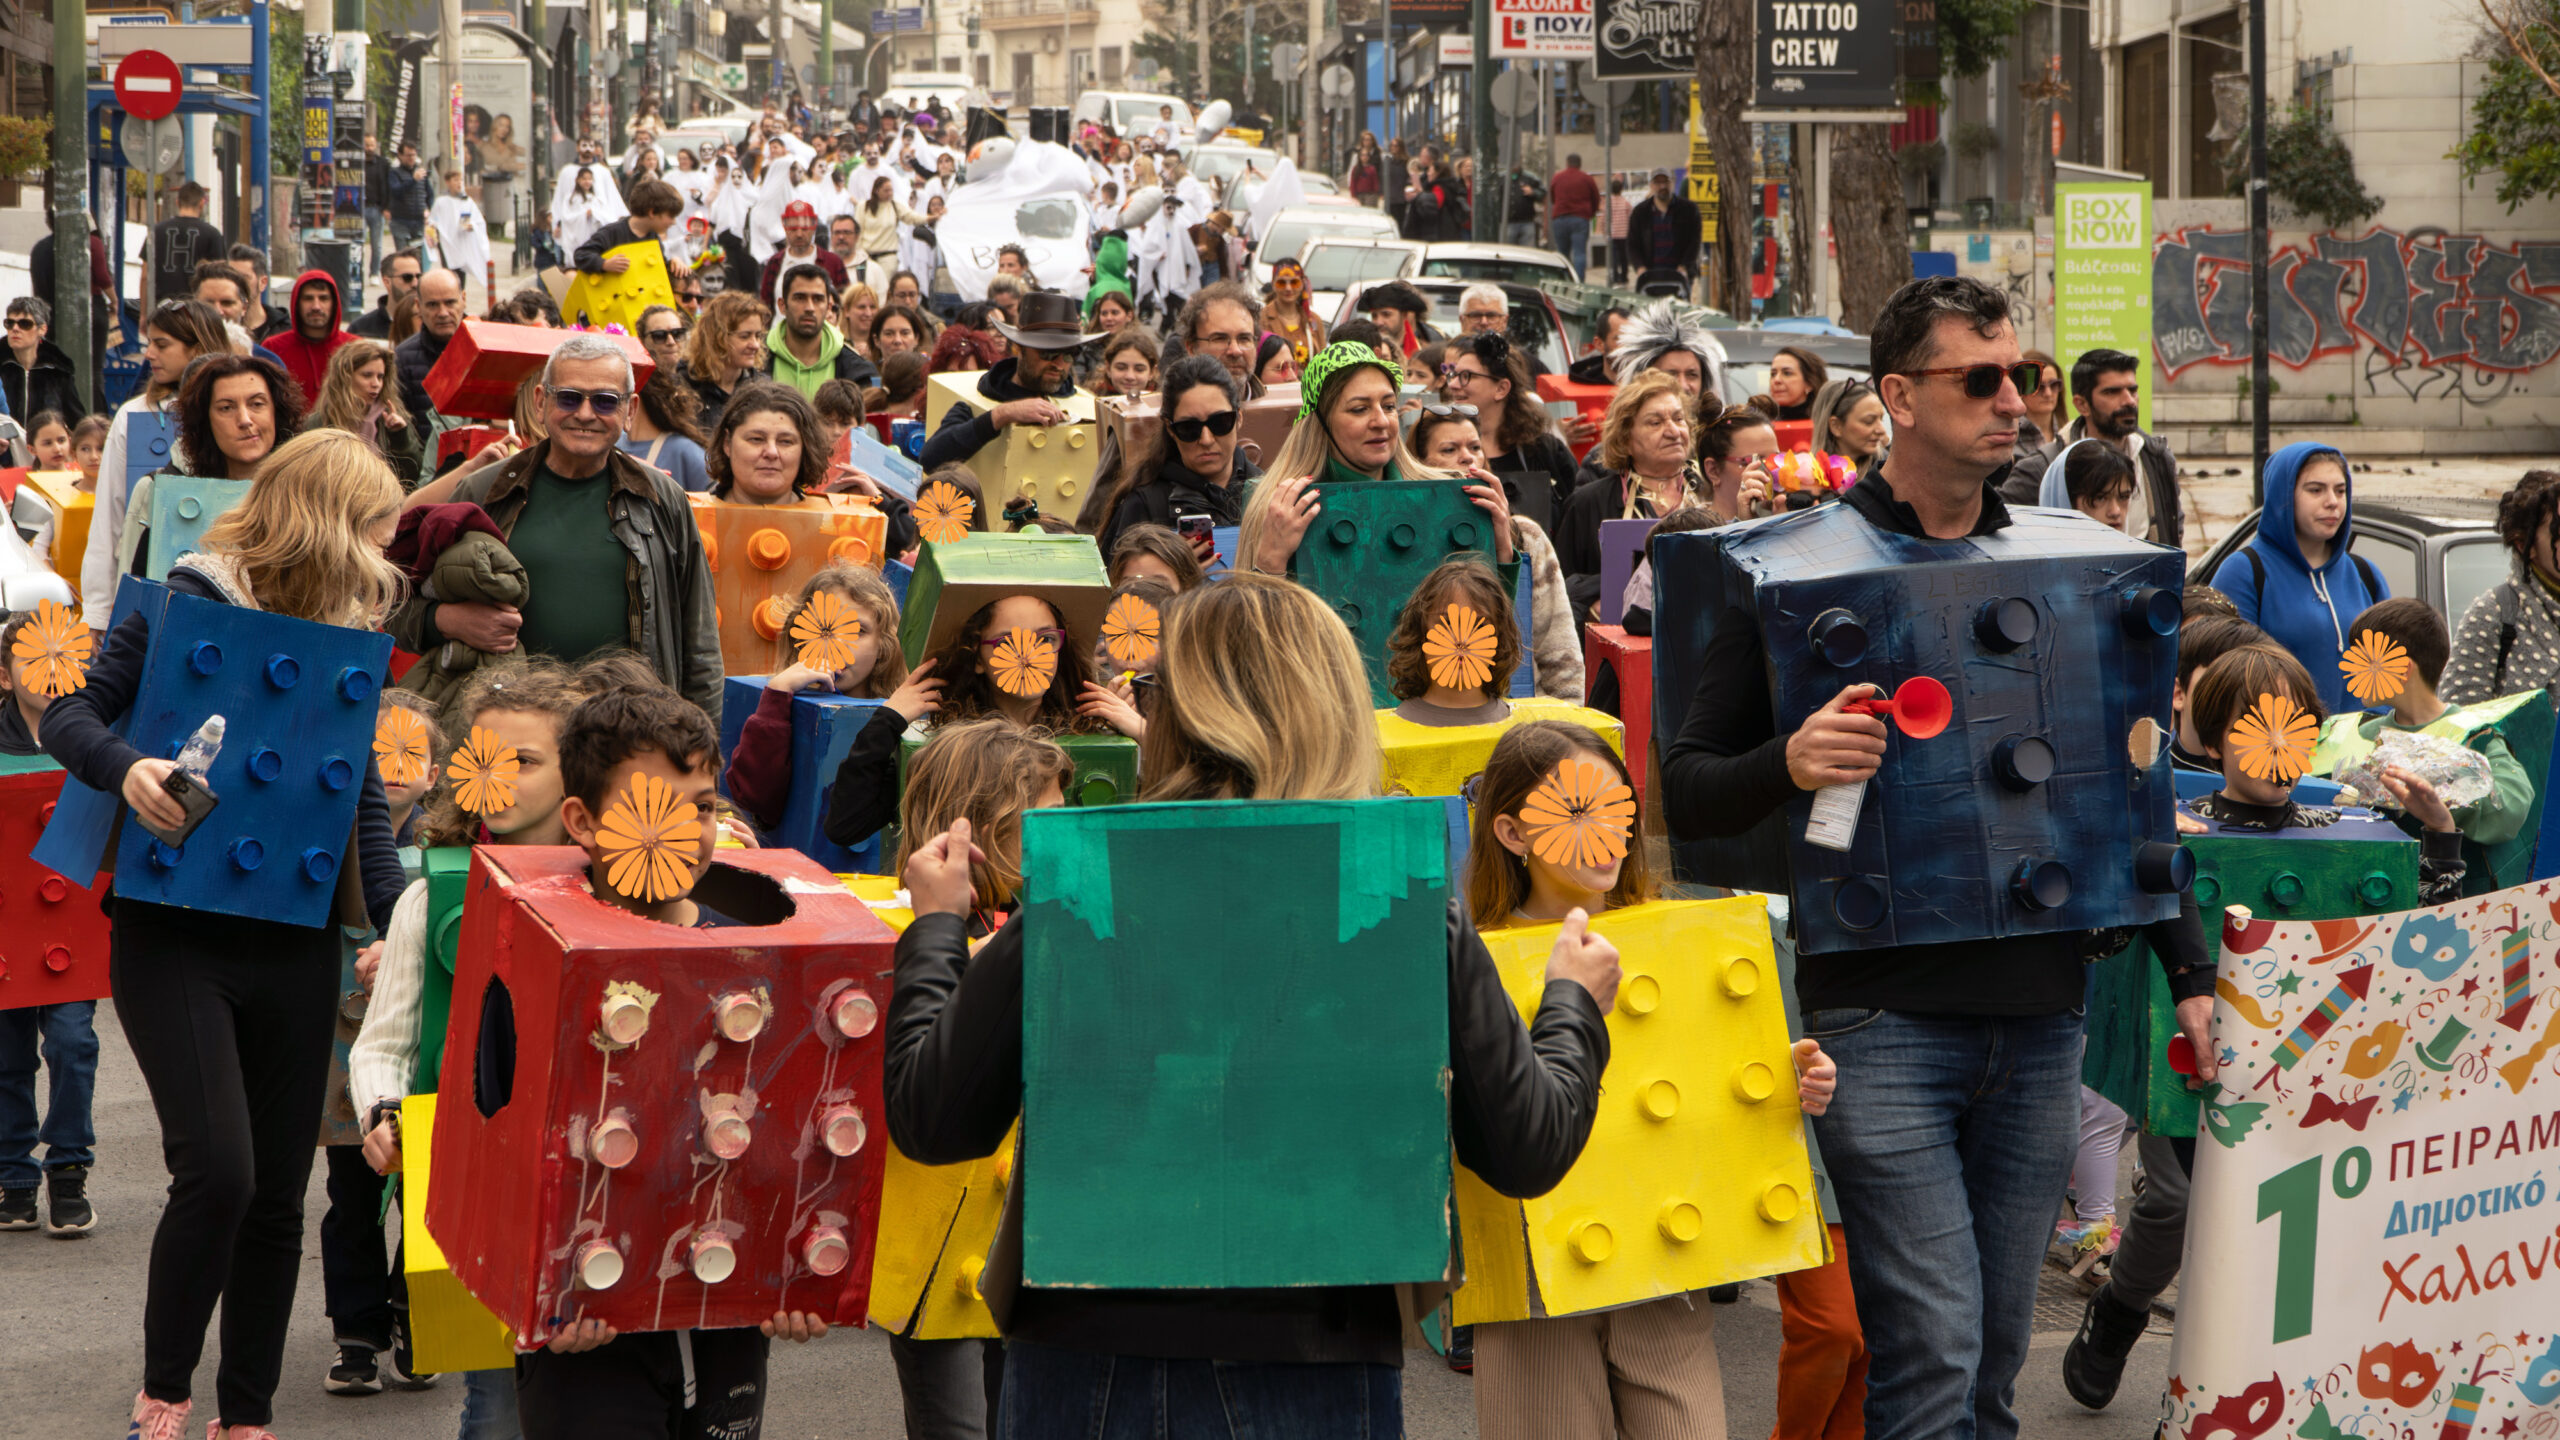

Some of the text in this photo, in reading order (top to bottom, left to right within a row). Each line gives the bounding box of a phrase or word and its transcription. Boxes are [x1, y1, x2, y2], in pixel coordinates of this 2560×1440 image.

[1772, 3, 1858, 31] TATTOO
[1771, 38, 1840, 67] CREW
[2071, 199, 2131, 221] BOX
[2071, 221, 2136, 243] NOW
[163, 227, 200, 274] H
[2064, 258, 2142, 277] Βιάζεσαι;
[2064, 283, 2103, 296] Στείλε
[2065, 299, 2127, 313] παράλαβε
[2066, 317, 2079, 326] το
[2383, 1170, 2546, 1240] Δημοτικό
[2378, 1224, 2560, 1323] Χαλαν
